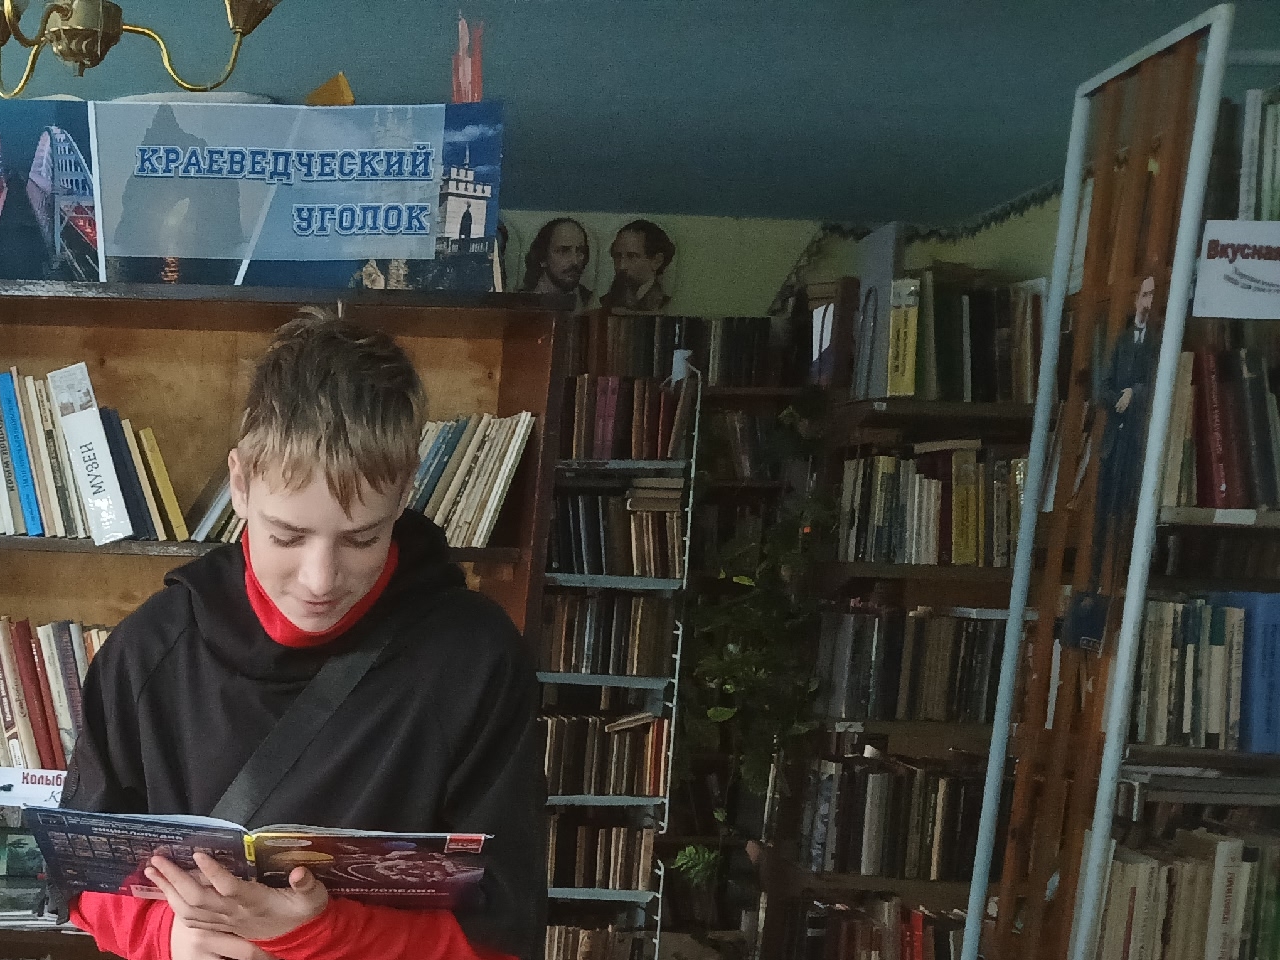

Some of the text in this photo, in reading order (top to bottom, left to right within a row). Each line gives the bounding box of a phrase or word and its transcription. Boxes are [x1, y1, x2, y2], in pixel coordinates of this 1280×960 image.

[135, 142, 434, 186] КРАЕВЕДЧЕСКИЙ
[292, 202, 430, 237] УГОЛОК
[22, 772, 65, 787] Колыб
